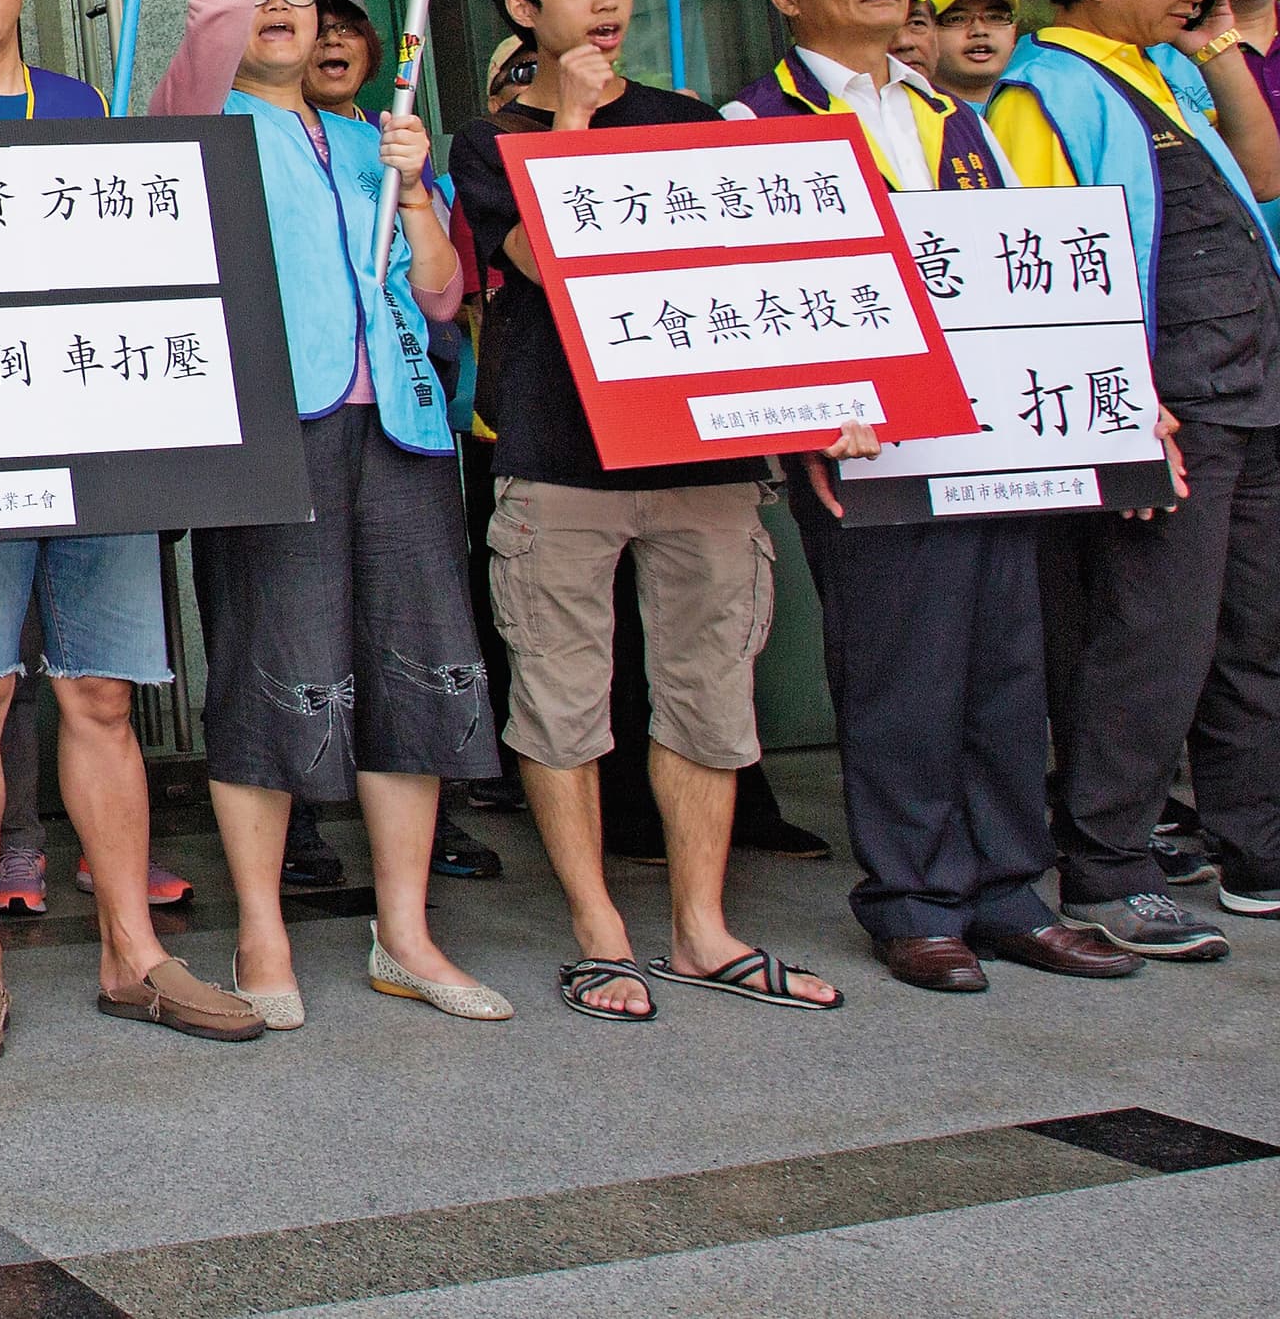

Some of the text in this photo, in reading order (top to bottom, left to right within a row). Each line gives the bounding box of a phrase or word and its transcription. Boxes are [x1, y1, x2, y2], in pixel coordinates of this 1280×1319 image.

[562, 171, 848, 233] 資方無意協商
[609, 284, 892, 349] 工會無奈投票
[710, 399, 866, 431] 桃園市機師職業工會
[970, 367, 1143, 437] 打壓
[945, 478, 1085, 503] 桃園市機師職業工會
